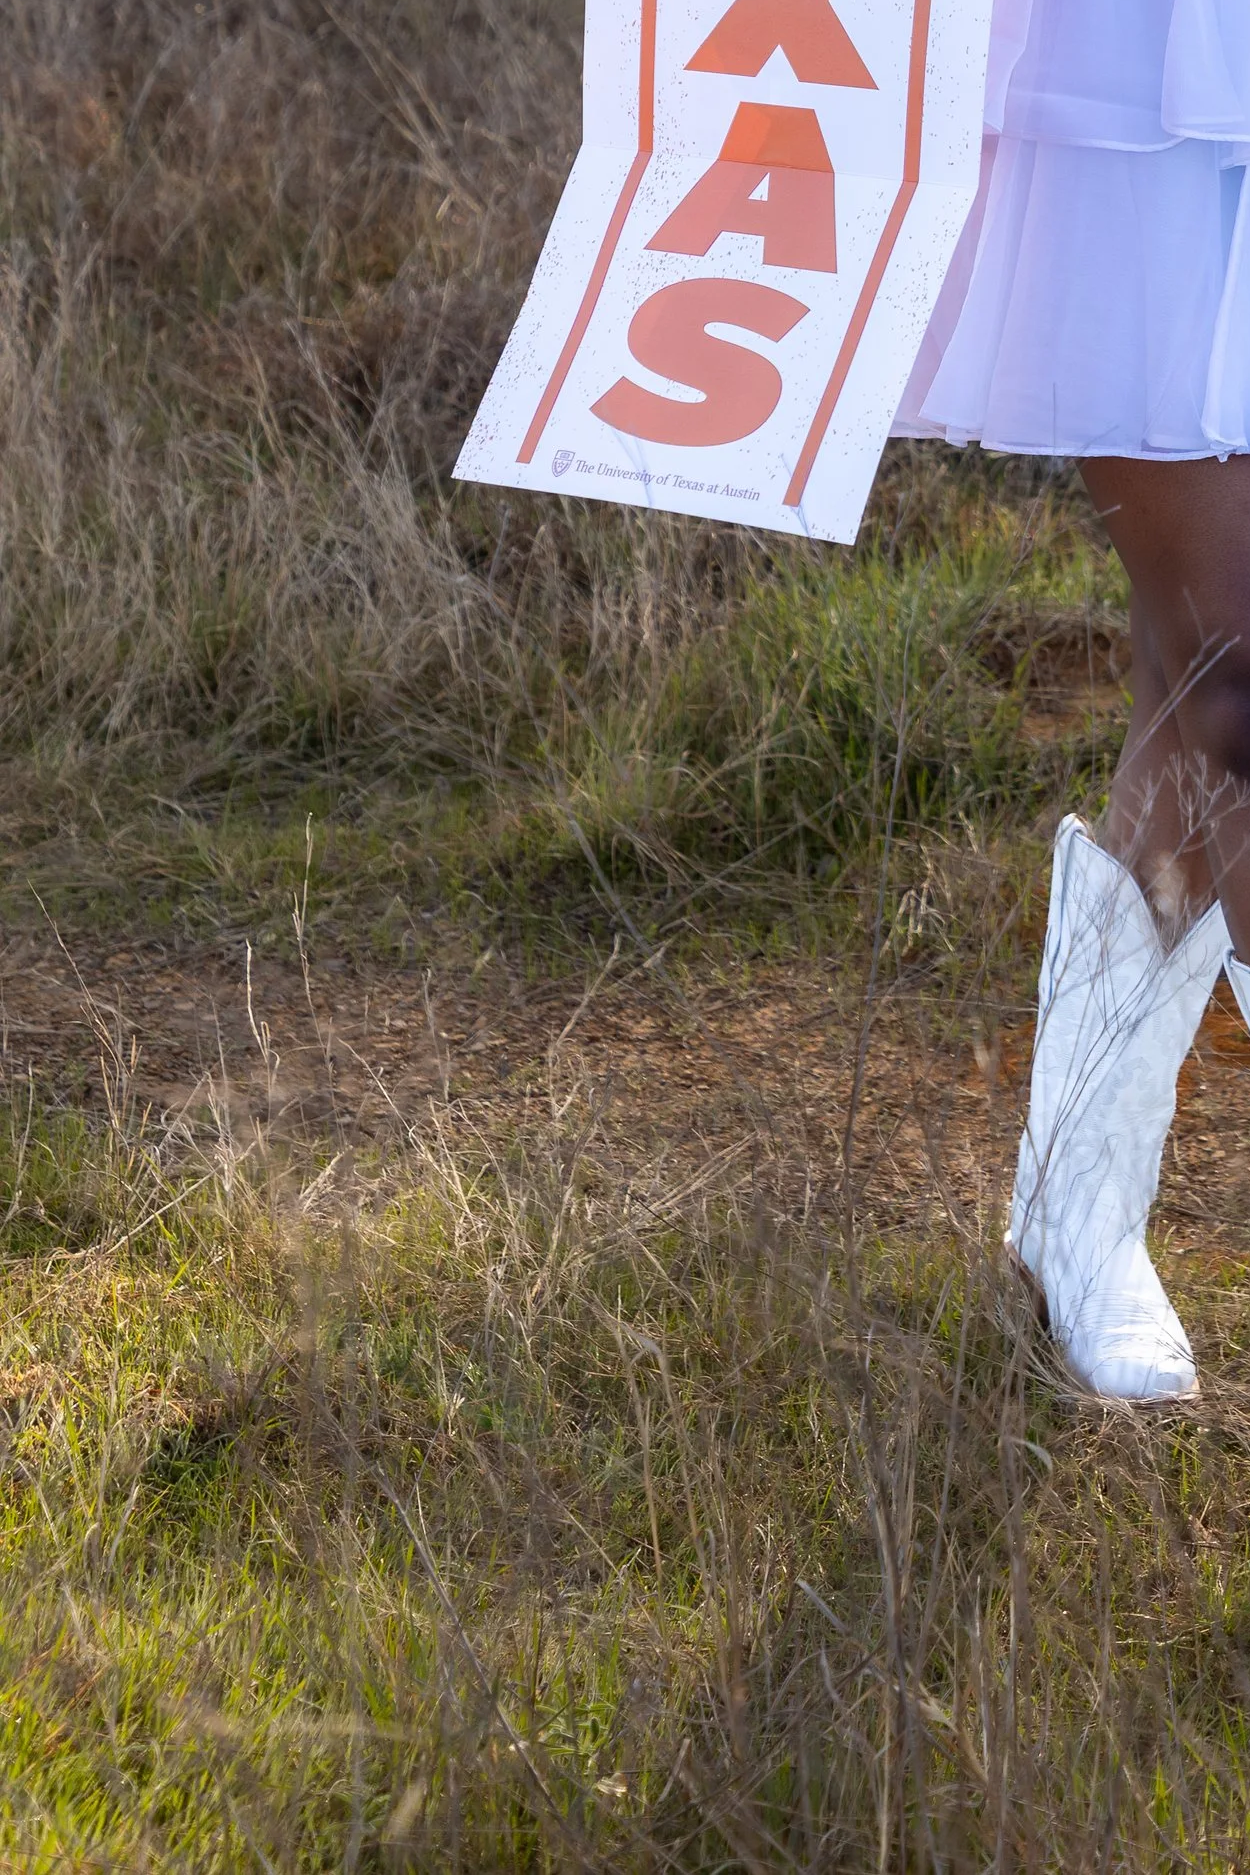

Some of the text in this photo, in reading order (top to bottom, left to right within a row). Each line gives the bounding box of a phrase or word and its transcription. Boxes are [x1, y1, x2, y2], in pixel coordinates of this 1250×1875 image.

[575, 459, 761, 502] The University of Texas at Austin
